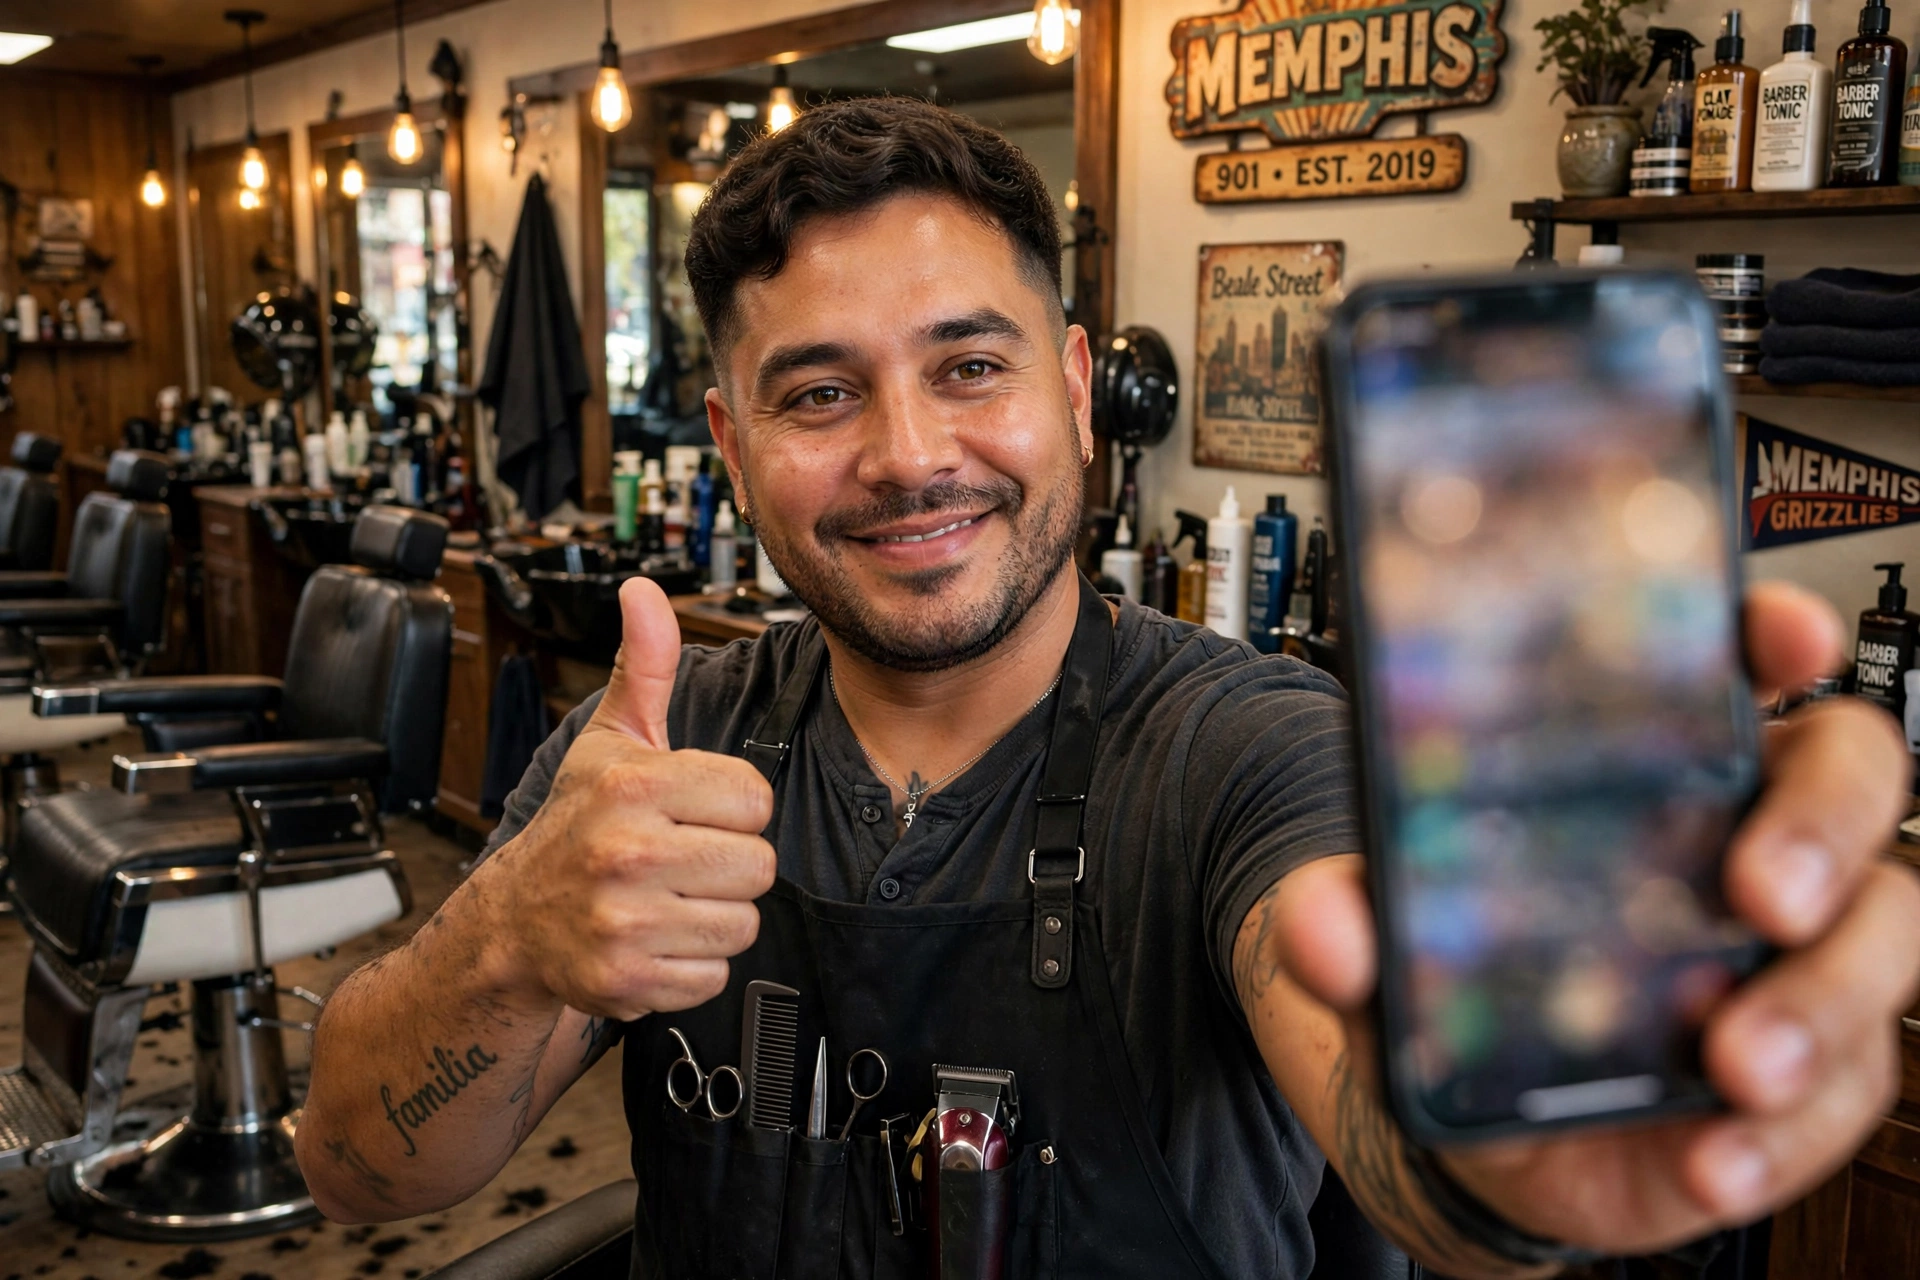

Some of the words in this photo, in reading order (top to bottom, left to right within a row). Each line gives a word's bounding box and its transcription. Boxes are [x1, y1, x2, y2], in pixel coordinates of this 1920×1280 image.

[1185, 7, 1476, 122] MEMPHIS
[1763, 85, 1807, 104] BARBER
[1837, 83, 1880, 103] BARBER
[1765, 102, 1802, 120] TONIC
[1839, 102, 1874, 119] TONIC
[1216, 162, 1260, 191] 901
[1296, 156, 1353, 185] EST.
[1366, 149, 1436, 181] 2019
[1211, 265, 1261, 299] Beale
[1265, 264, 1325, 298] Street
[1772, 440, 1920, 505] MEMPHIS
[1770, 500, 1900, 531] GRIZZLIES
[1858, 640, 1899, 667] BARBER
[1857, 662, 1895, 687] TONIC
[380, 1043, 498, 1157] familia
